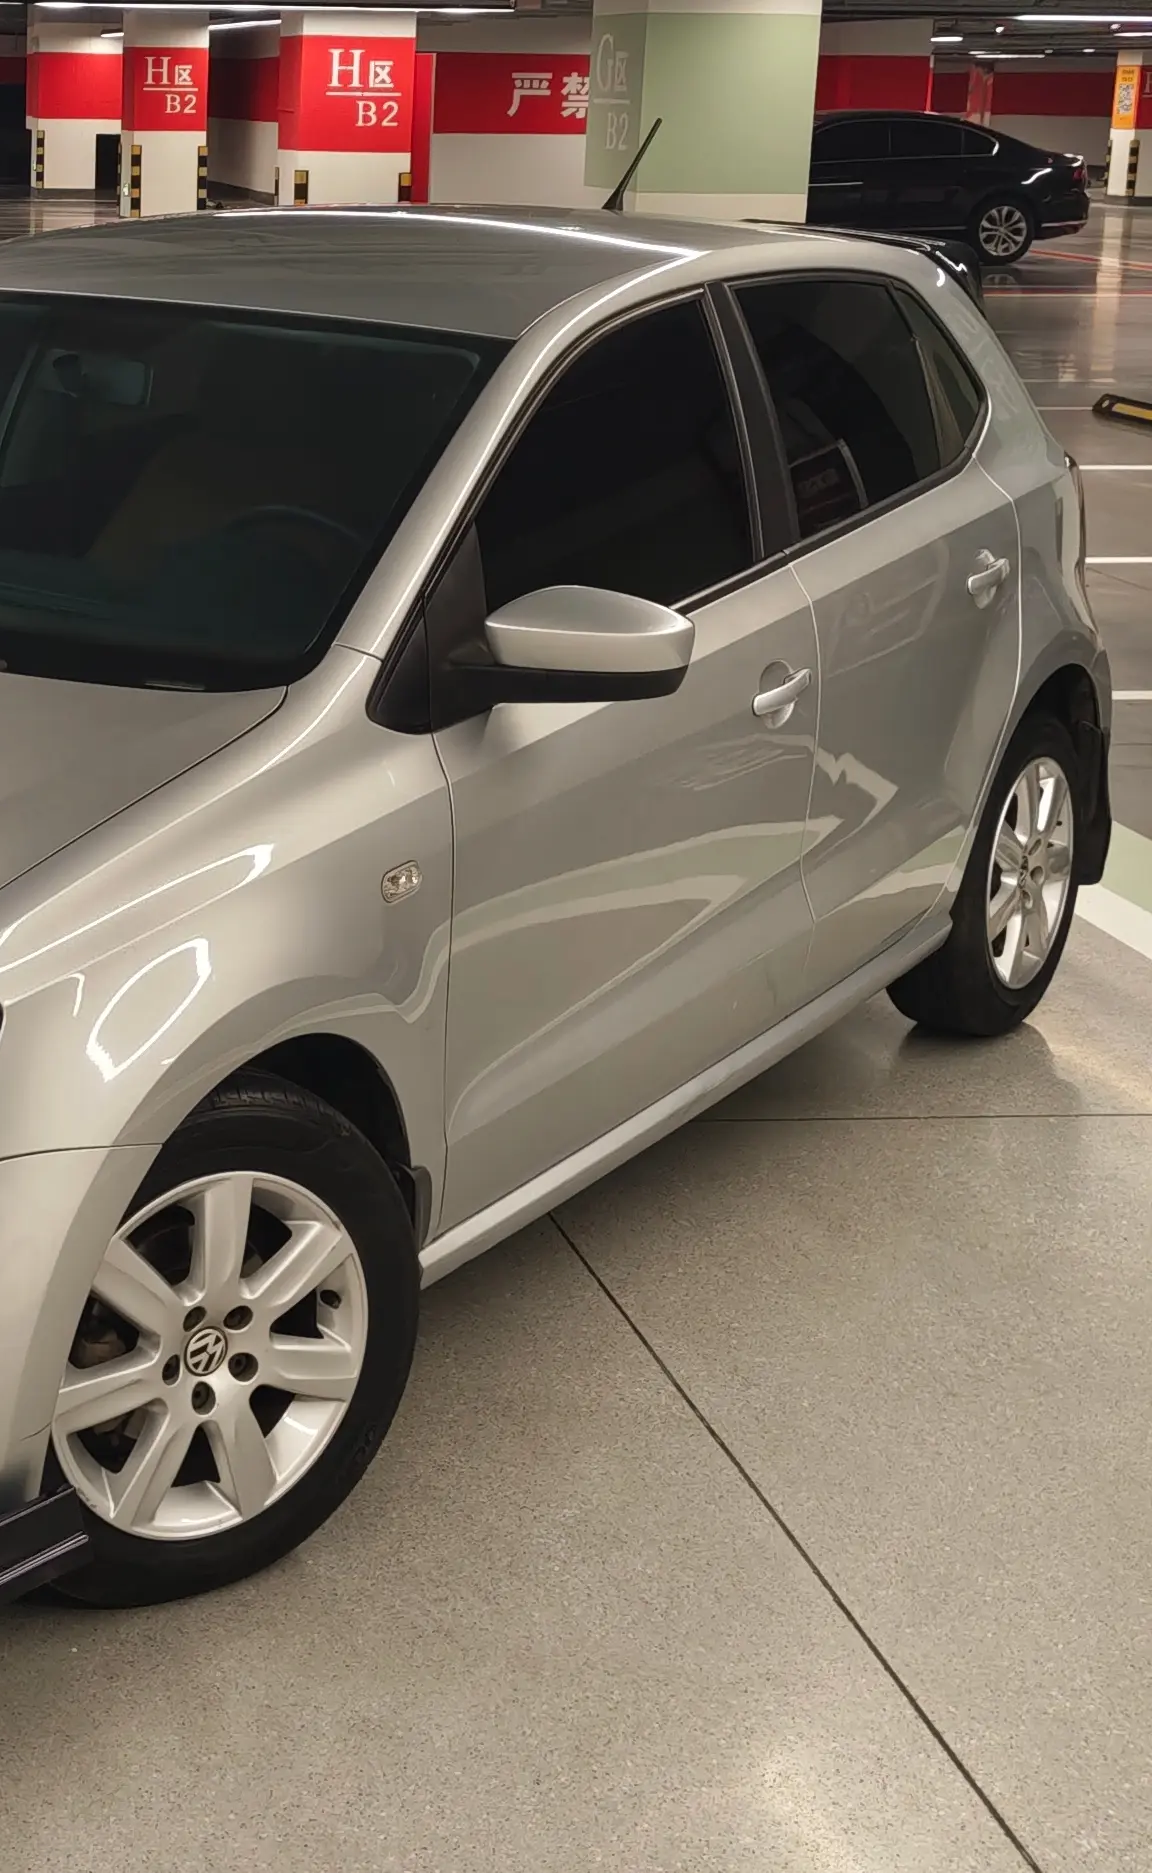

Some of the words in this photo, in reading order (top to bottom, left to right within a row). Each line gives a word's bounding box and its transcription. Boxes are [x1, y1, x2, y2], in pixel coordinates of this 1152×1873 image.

[144, 56, 194, 85] H区
[327, 48, 394, 88] H区
[164, 93, 197, 114] B2
[355, 100, 399, 127] B2
[605, 112, 628, 150] B2
